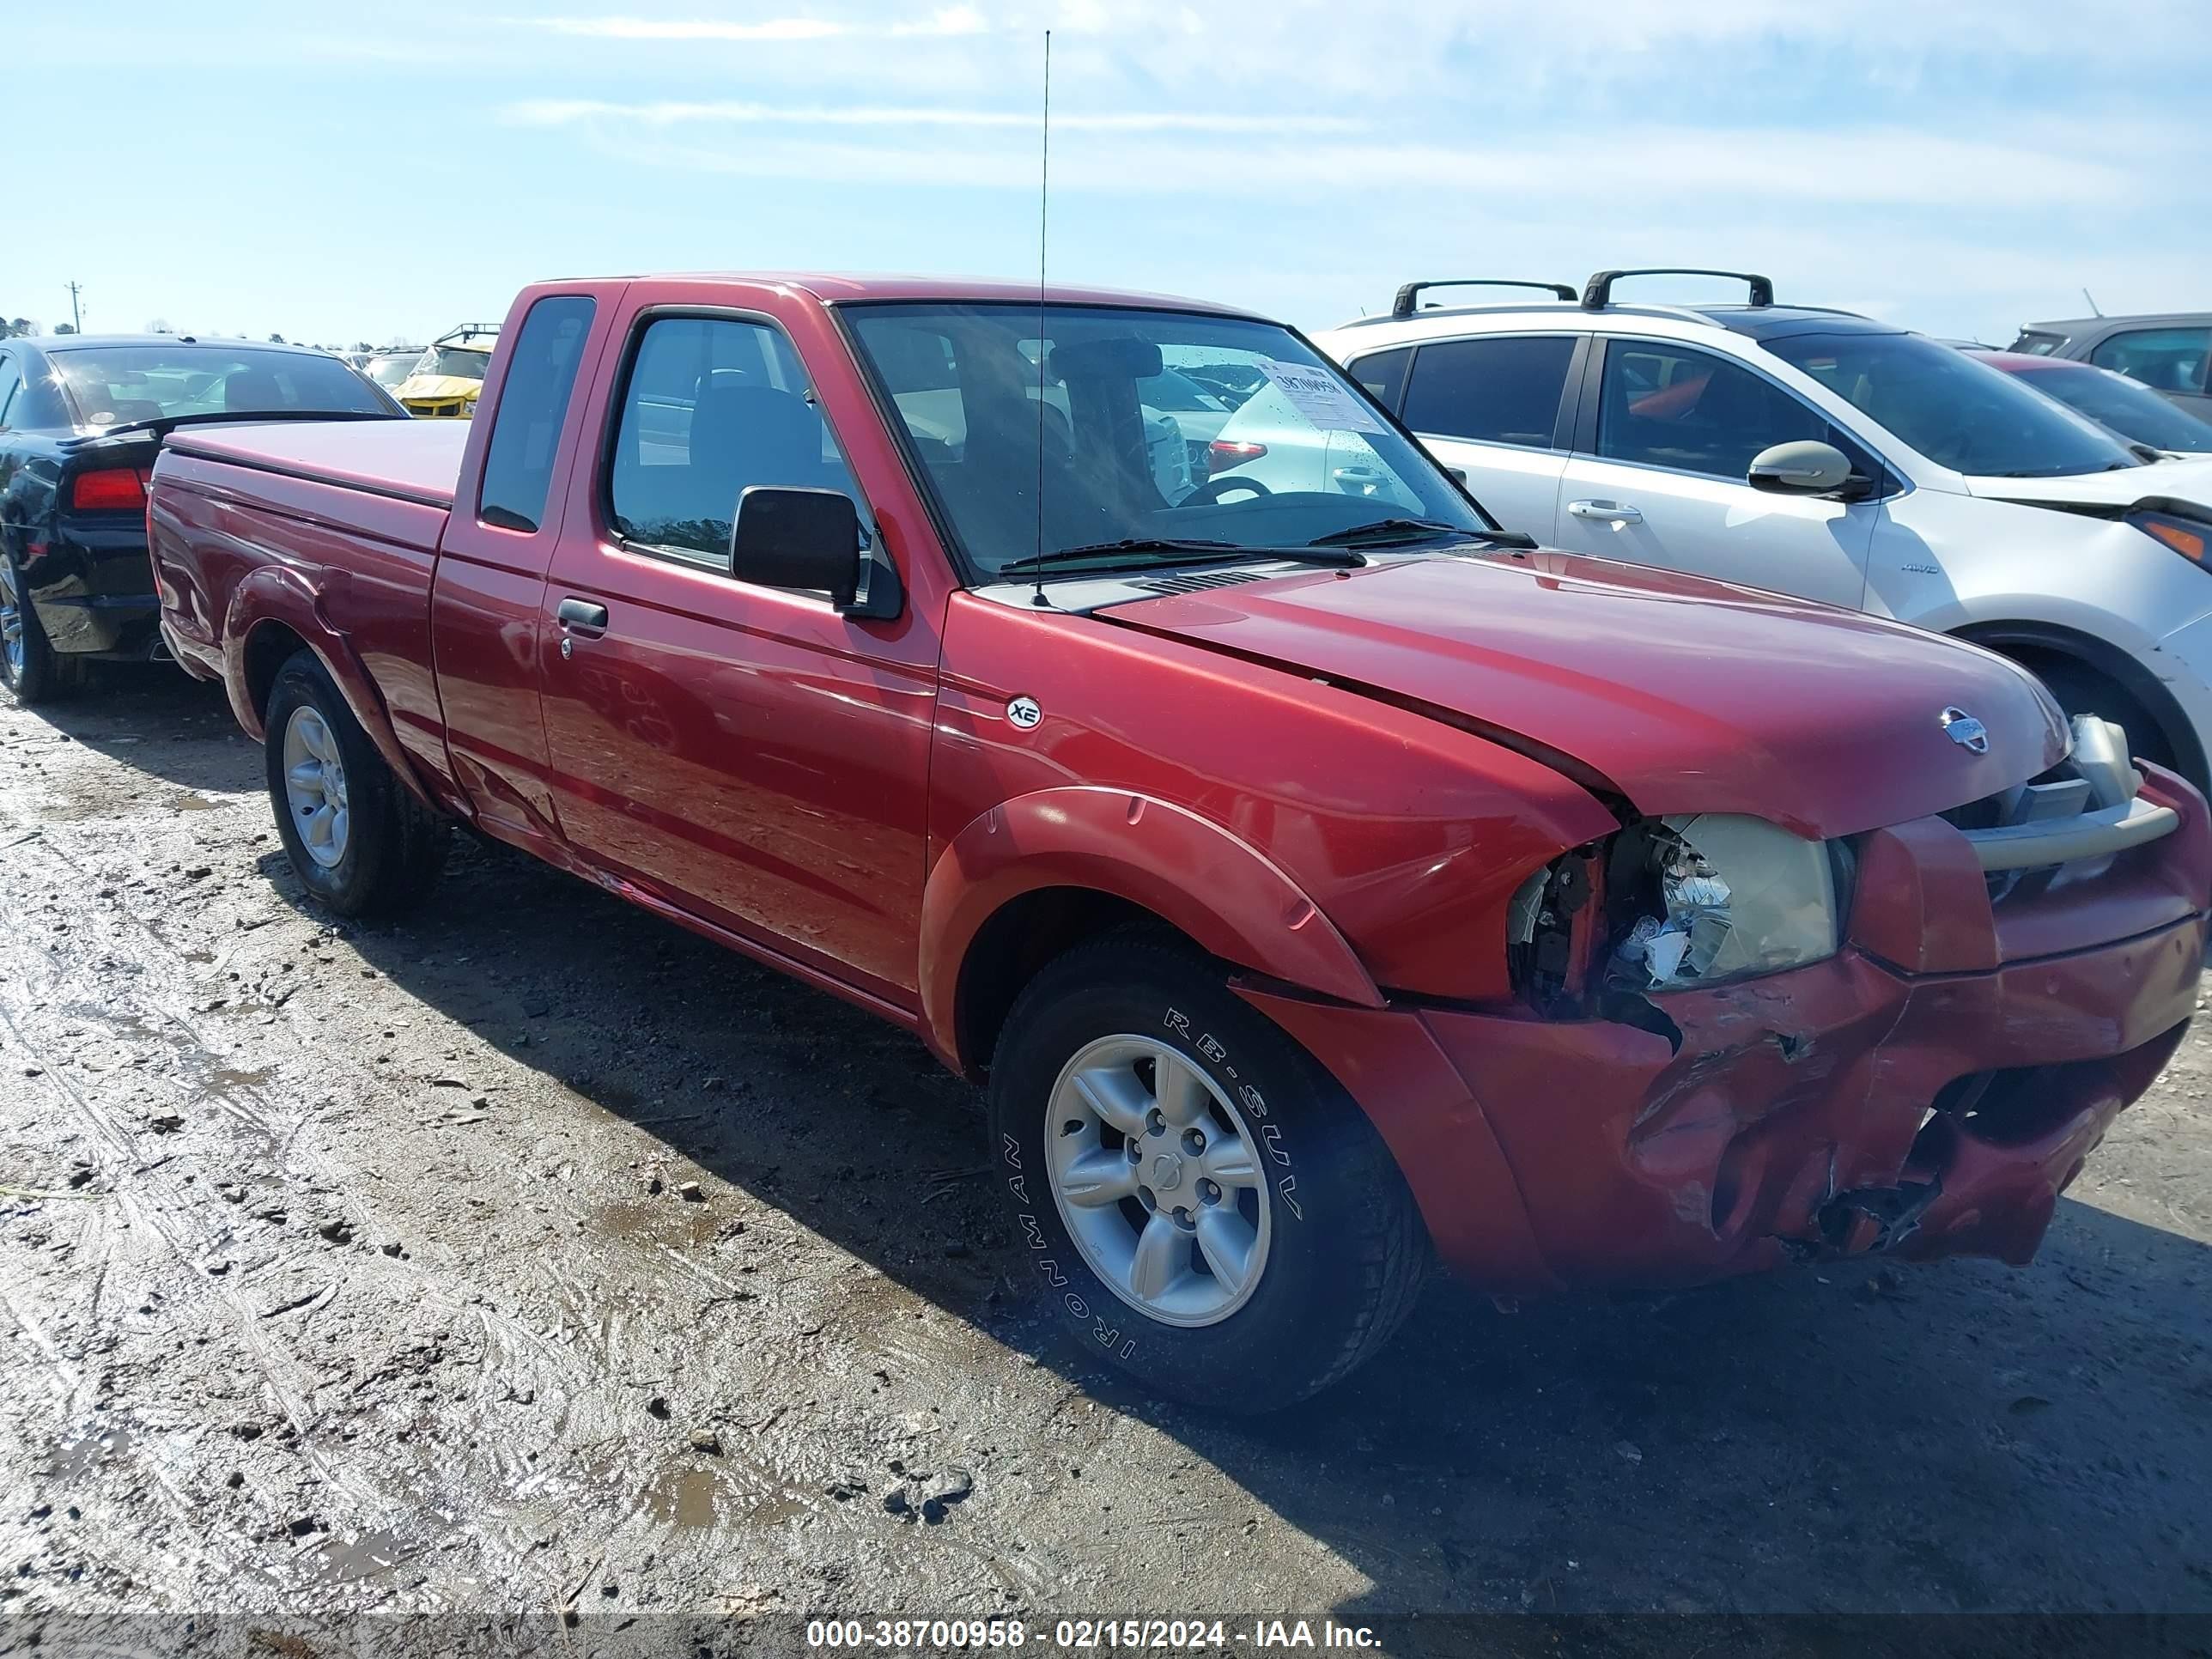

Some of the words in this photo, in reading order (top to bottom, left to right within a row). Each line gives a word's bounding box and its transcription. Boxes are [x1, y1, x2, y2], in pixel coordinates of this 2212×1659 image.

[1901, 563, 1938, 574] AWD
[1011, 703, 1037, 723] XE
[1163, 1006, 1304, 1223] RB-SUV
[1003, 1132, 1138, 1359] IRONMAN
